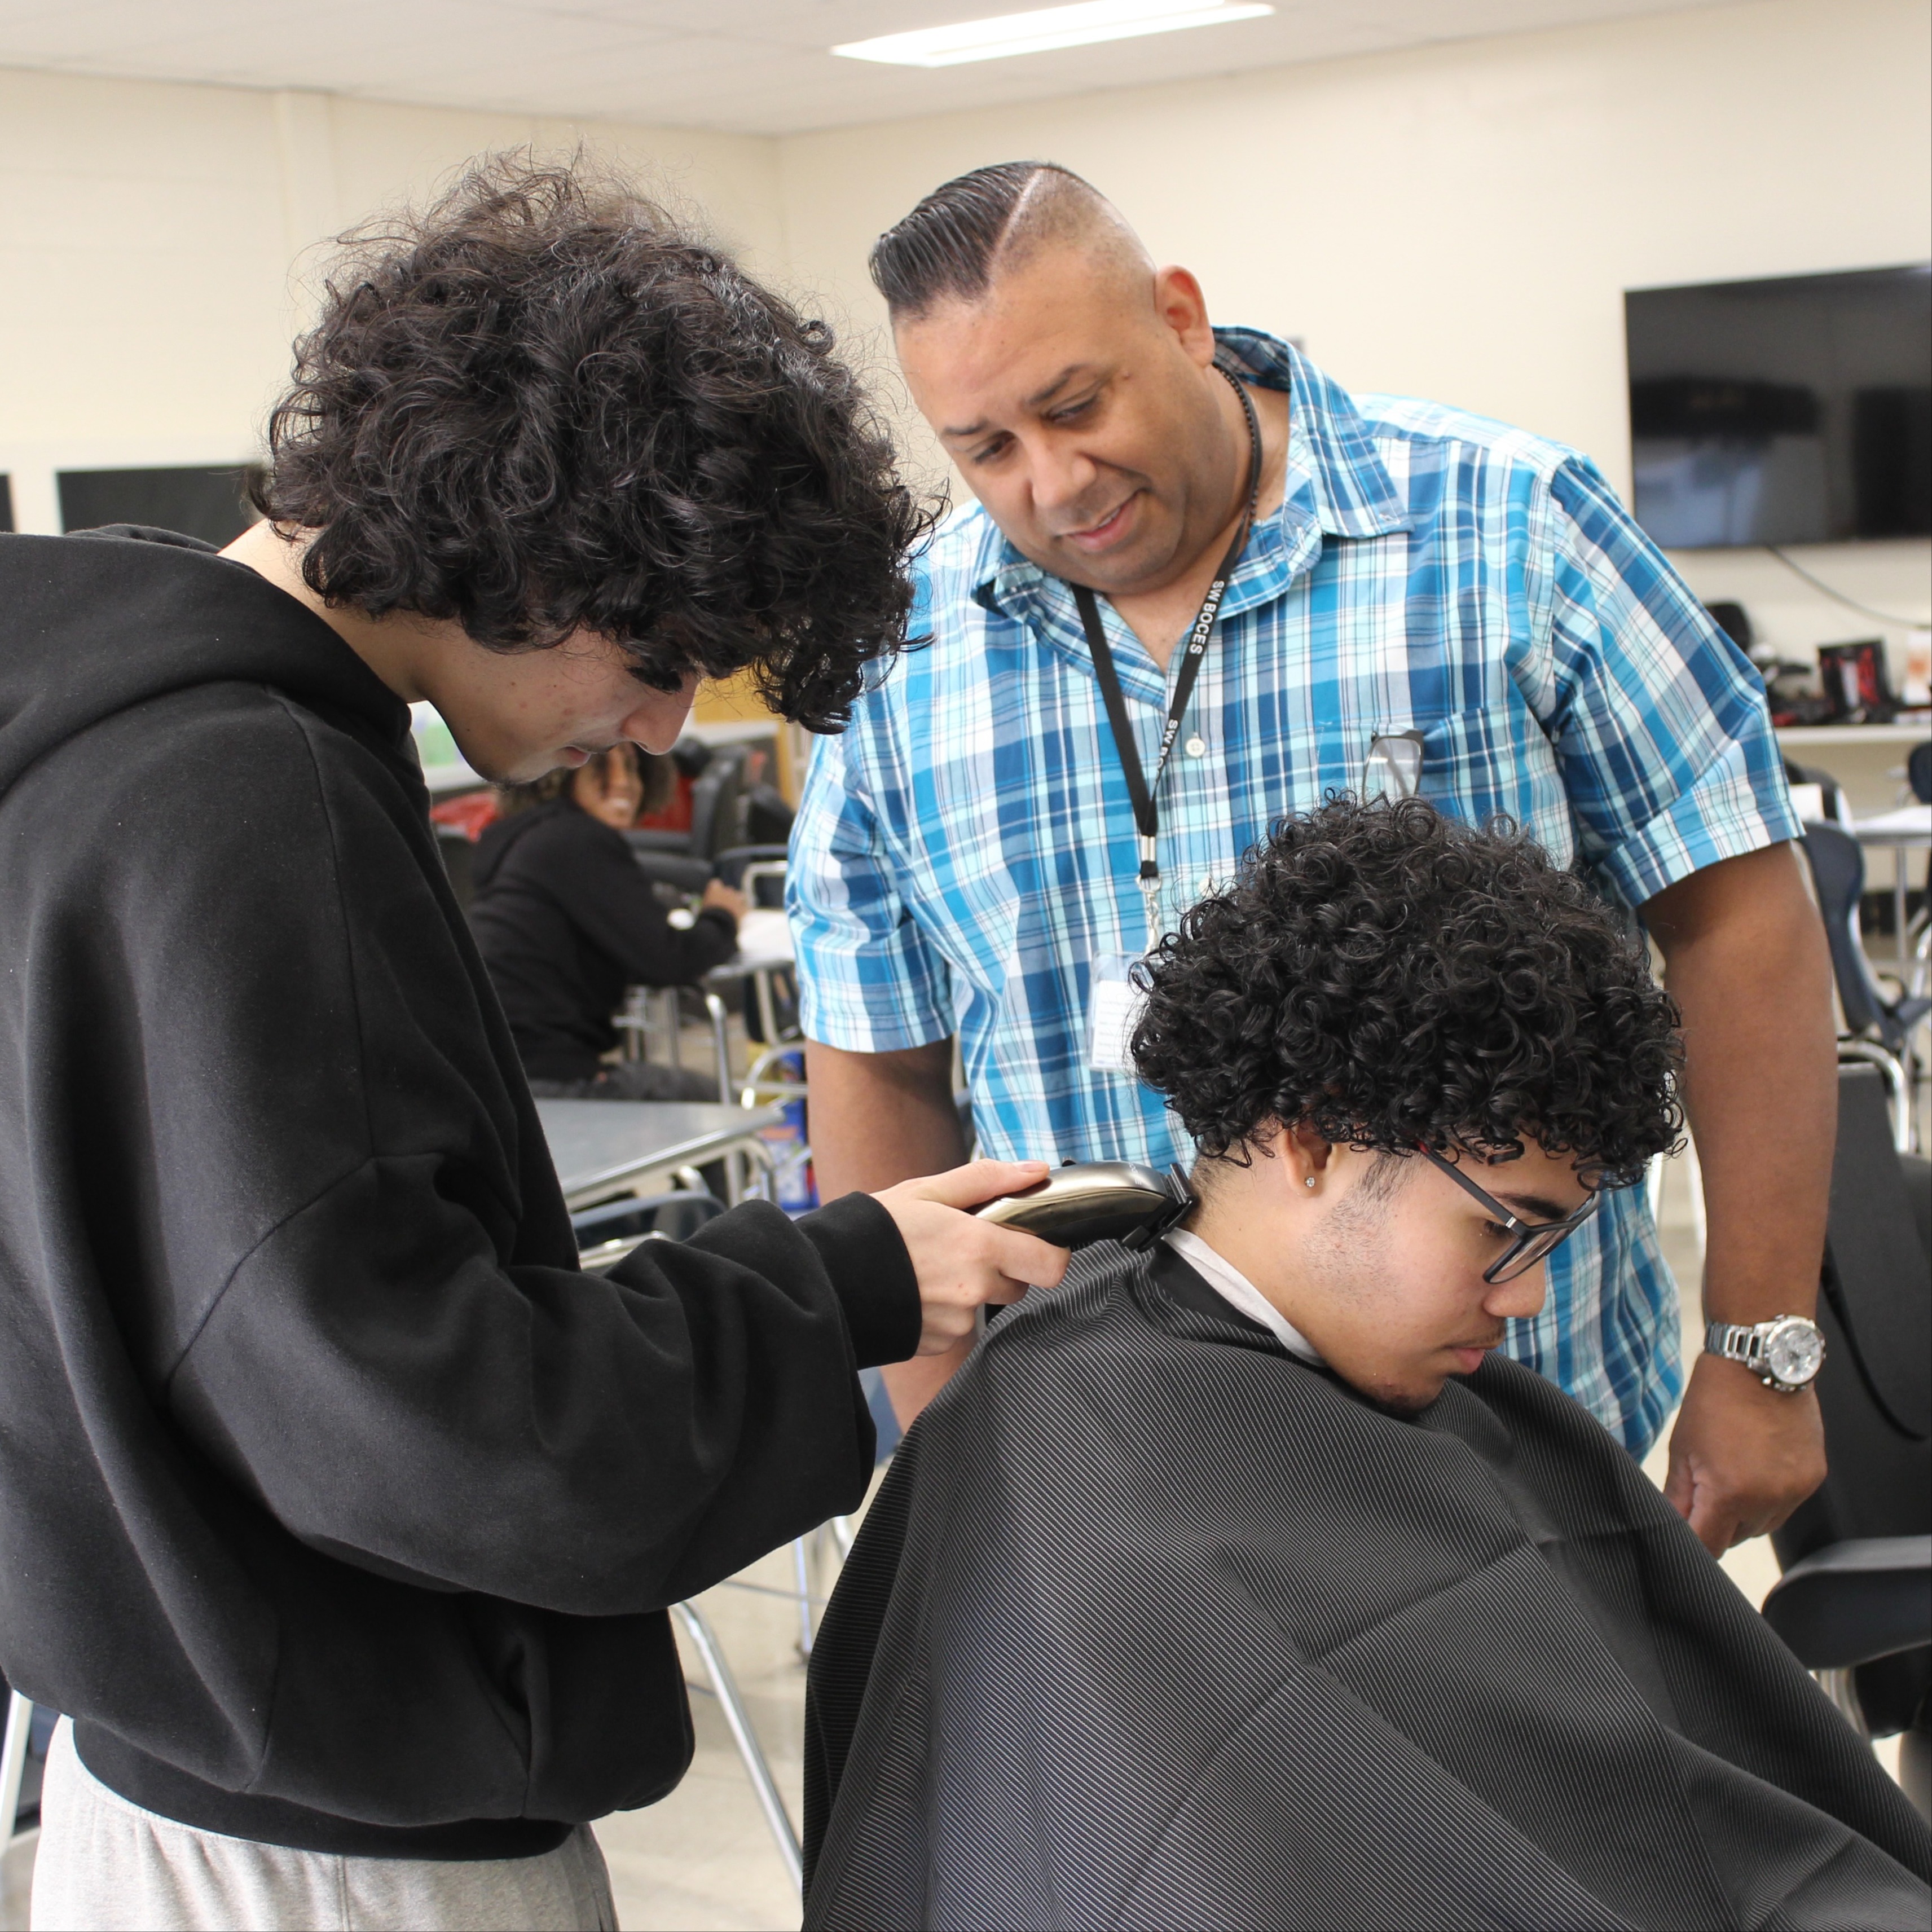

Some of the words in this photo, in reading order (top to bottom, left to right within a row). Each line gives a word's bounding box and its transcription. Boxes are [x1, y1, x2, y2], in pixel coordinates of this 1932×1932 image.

[1208, 580, 1225, 602] SW
[1189, 602, 1217, 654] BOCES
[1164, 719, 1178, 744] SW
